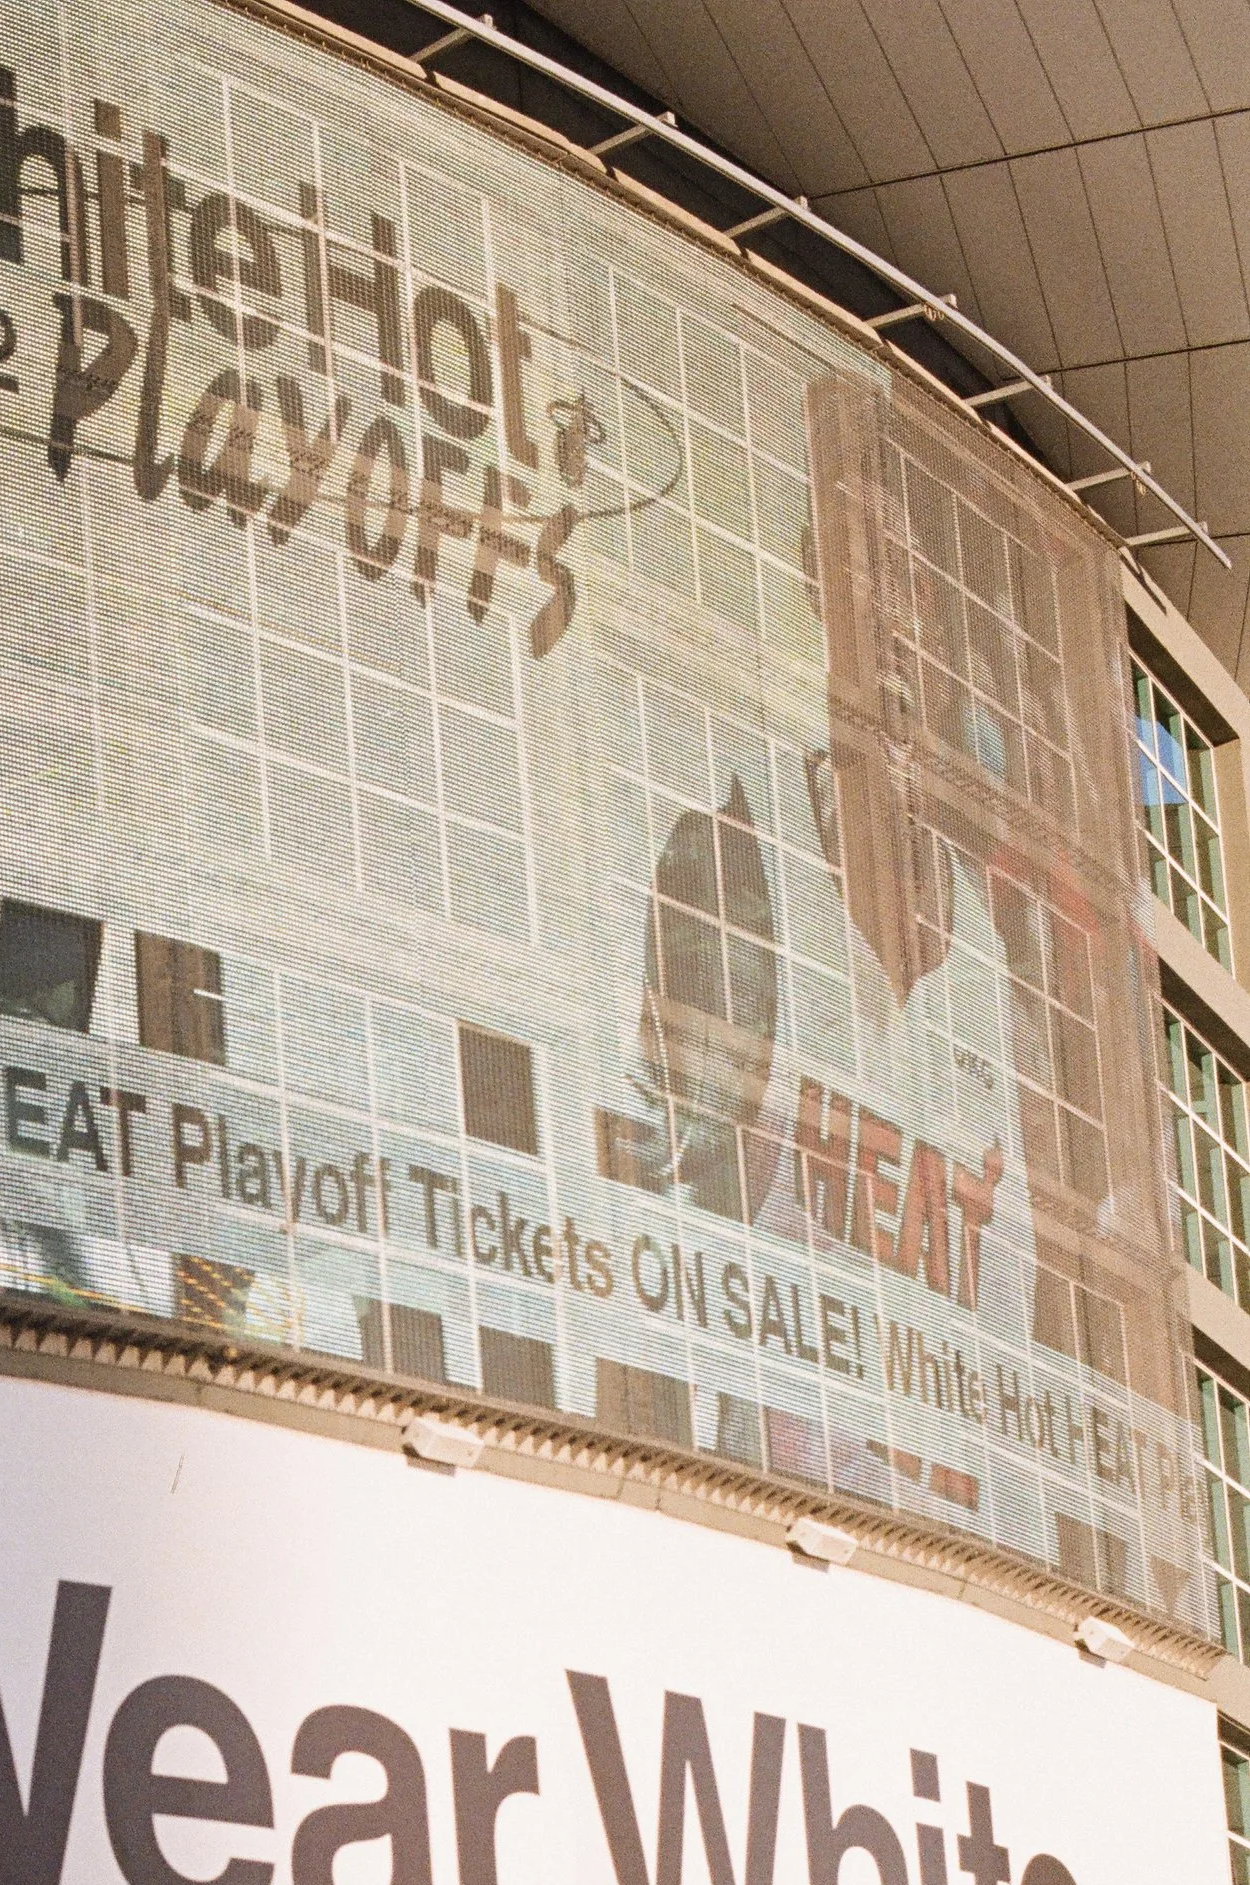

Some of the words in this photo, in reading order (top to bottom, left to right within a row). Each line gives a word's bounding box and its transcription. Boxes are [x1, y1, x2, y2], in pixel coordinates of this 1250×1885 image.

[298, 181, 539, 471] Hot
[171, 1103, 393, 1233] Playoff
[408, 1163, 616, 1299] Tickets
[630, 1234, 710, 1328] ON
[720, 1261, 866, 1380] SALE!
[872, 1312, 988, 1426] White
[995, 1363, 1061, 1461] Hot
[792, 1073, 1006, 1313] HEAT
